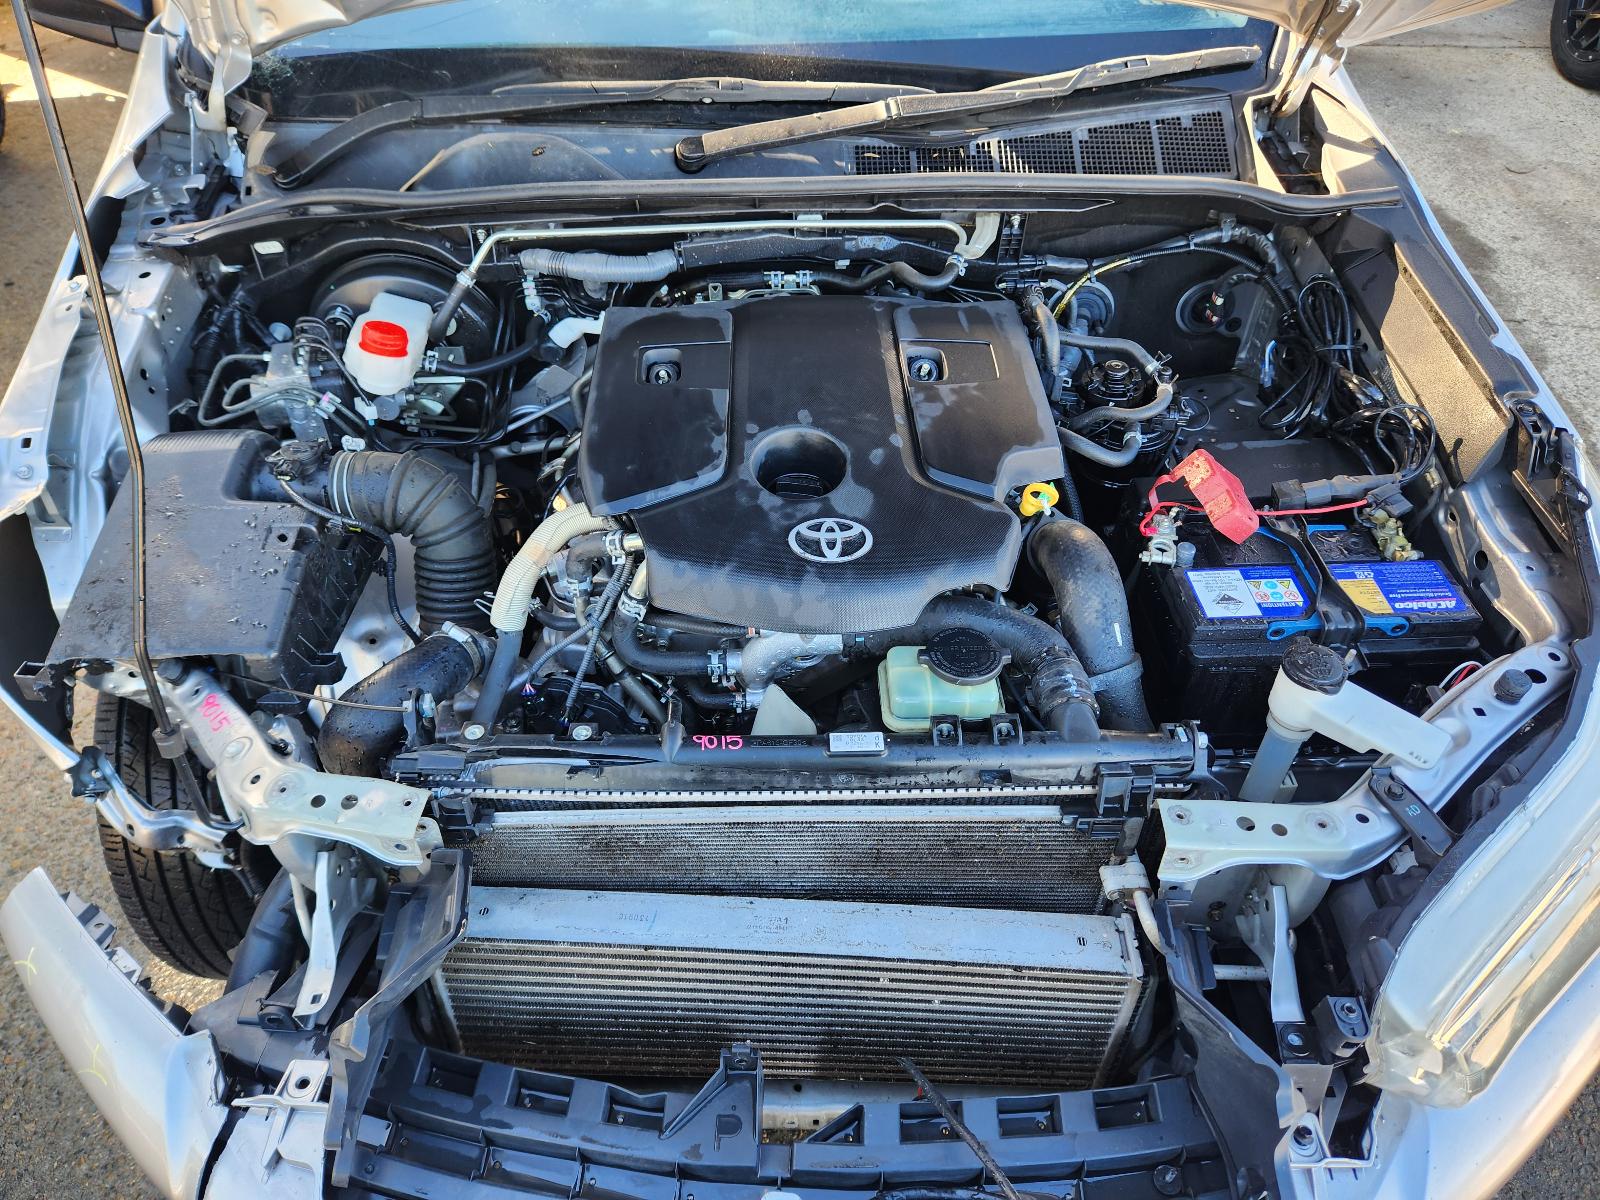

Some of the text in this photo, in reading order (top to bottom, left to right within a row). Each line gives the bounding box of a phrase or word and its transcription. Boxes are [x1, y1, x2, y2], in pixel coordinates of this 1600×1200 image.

[1394, 600, 1457, 610] ACDelco
[198, 694, 233, 732] 9015
[692, 734, 744, 752] 9015
